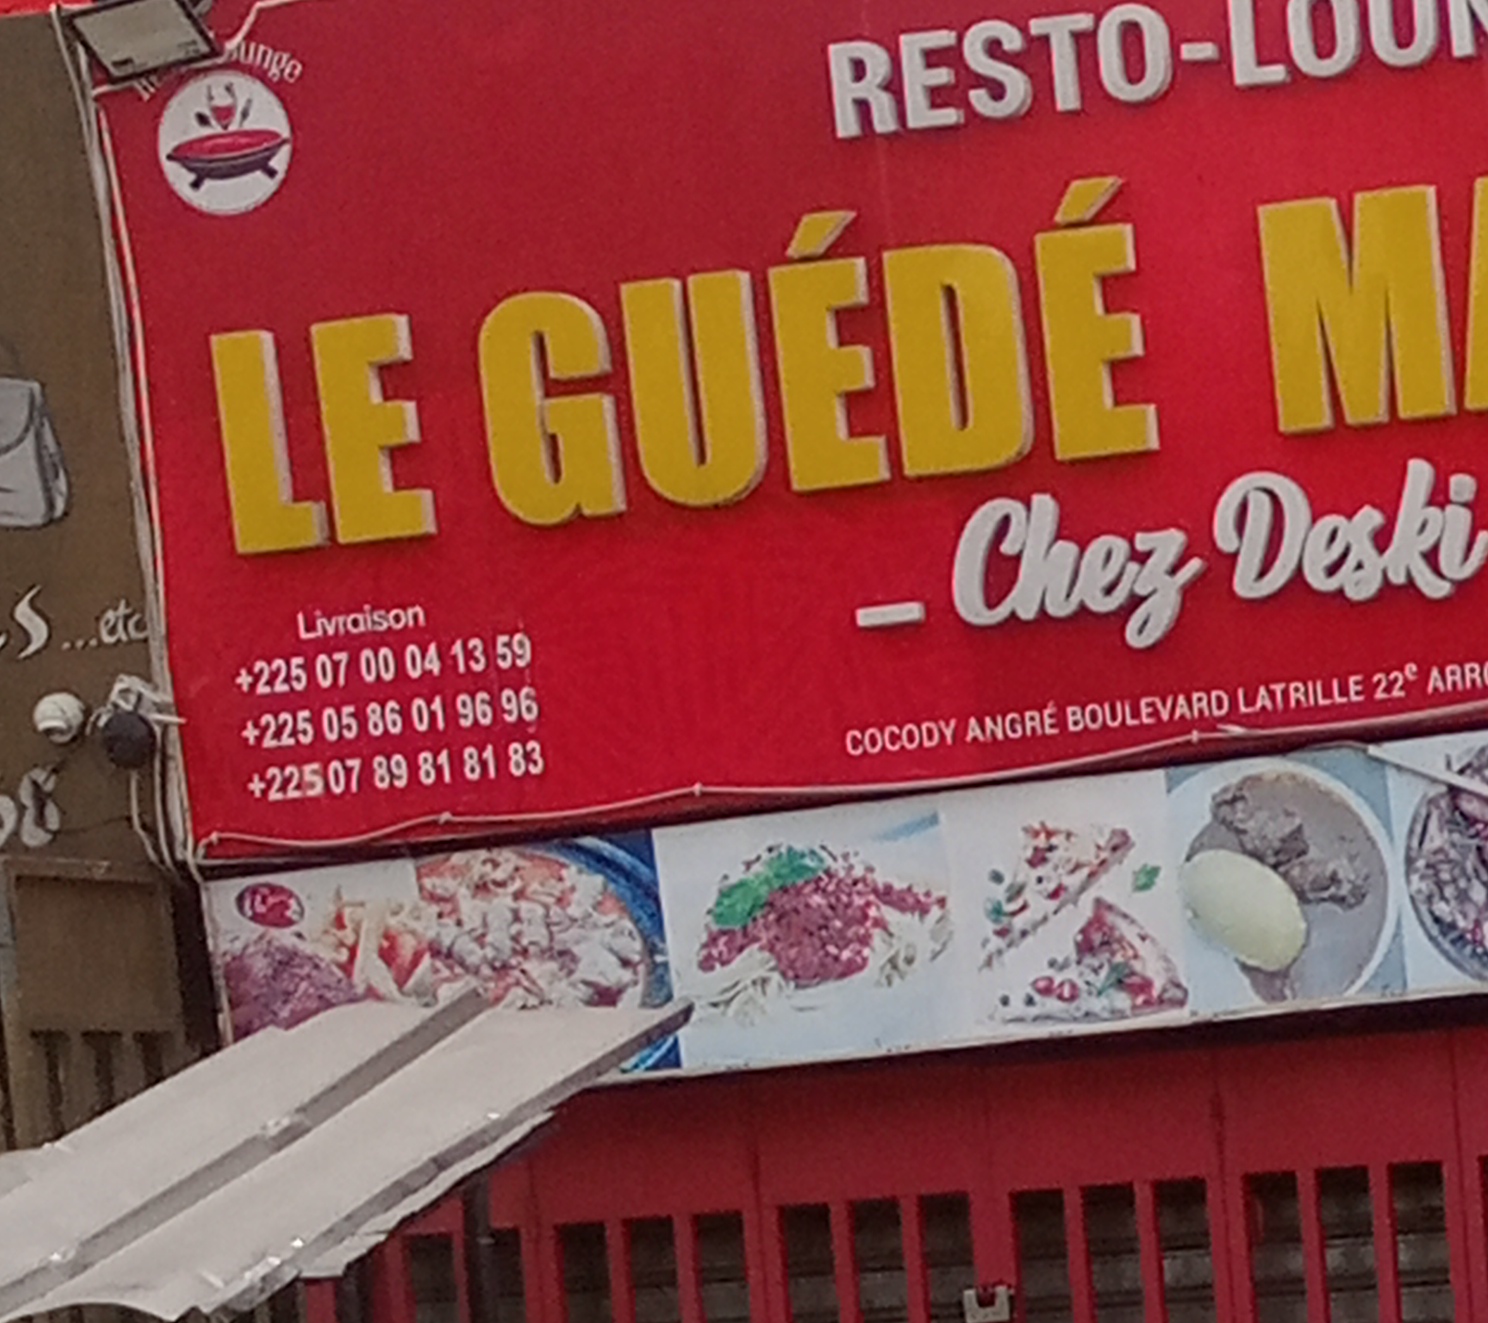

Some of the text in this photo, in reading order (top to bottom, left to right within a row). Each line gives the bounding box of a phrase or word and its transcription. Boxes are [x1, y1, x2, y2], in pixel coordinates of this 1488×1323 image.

[210, 313, 437, 555] LE
[477, 176, 1160, 527] GUÉDÉ
[952, 492, 1206, 648] Chez
[297, 604, 426, 640] Livraison
[235, 632, 533, 696] +225 07 00 04 13 59
[241, 685, 540, 749] +225 05 86 01 96 96
[845, 719, 956, 757] COCODY
[965, 699, 1060, 744] ANGRÉ
[1067, 690, 1230, 731] BOULEVARD
[1238, 676, 1366, 714] LATRILLE
[247, 739, 545, 803] +225 07 89 81 81 83
